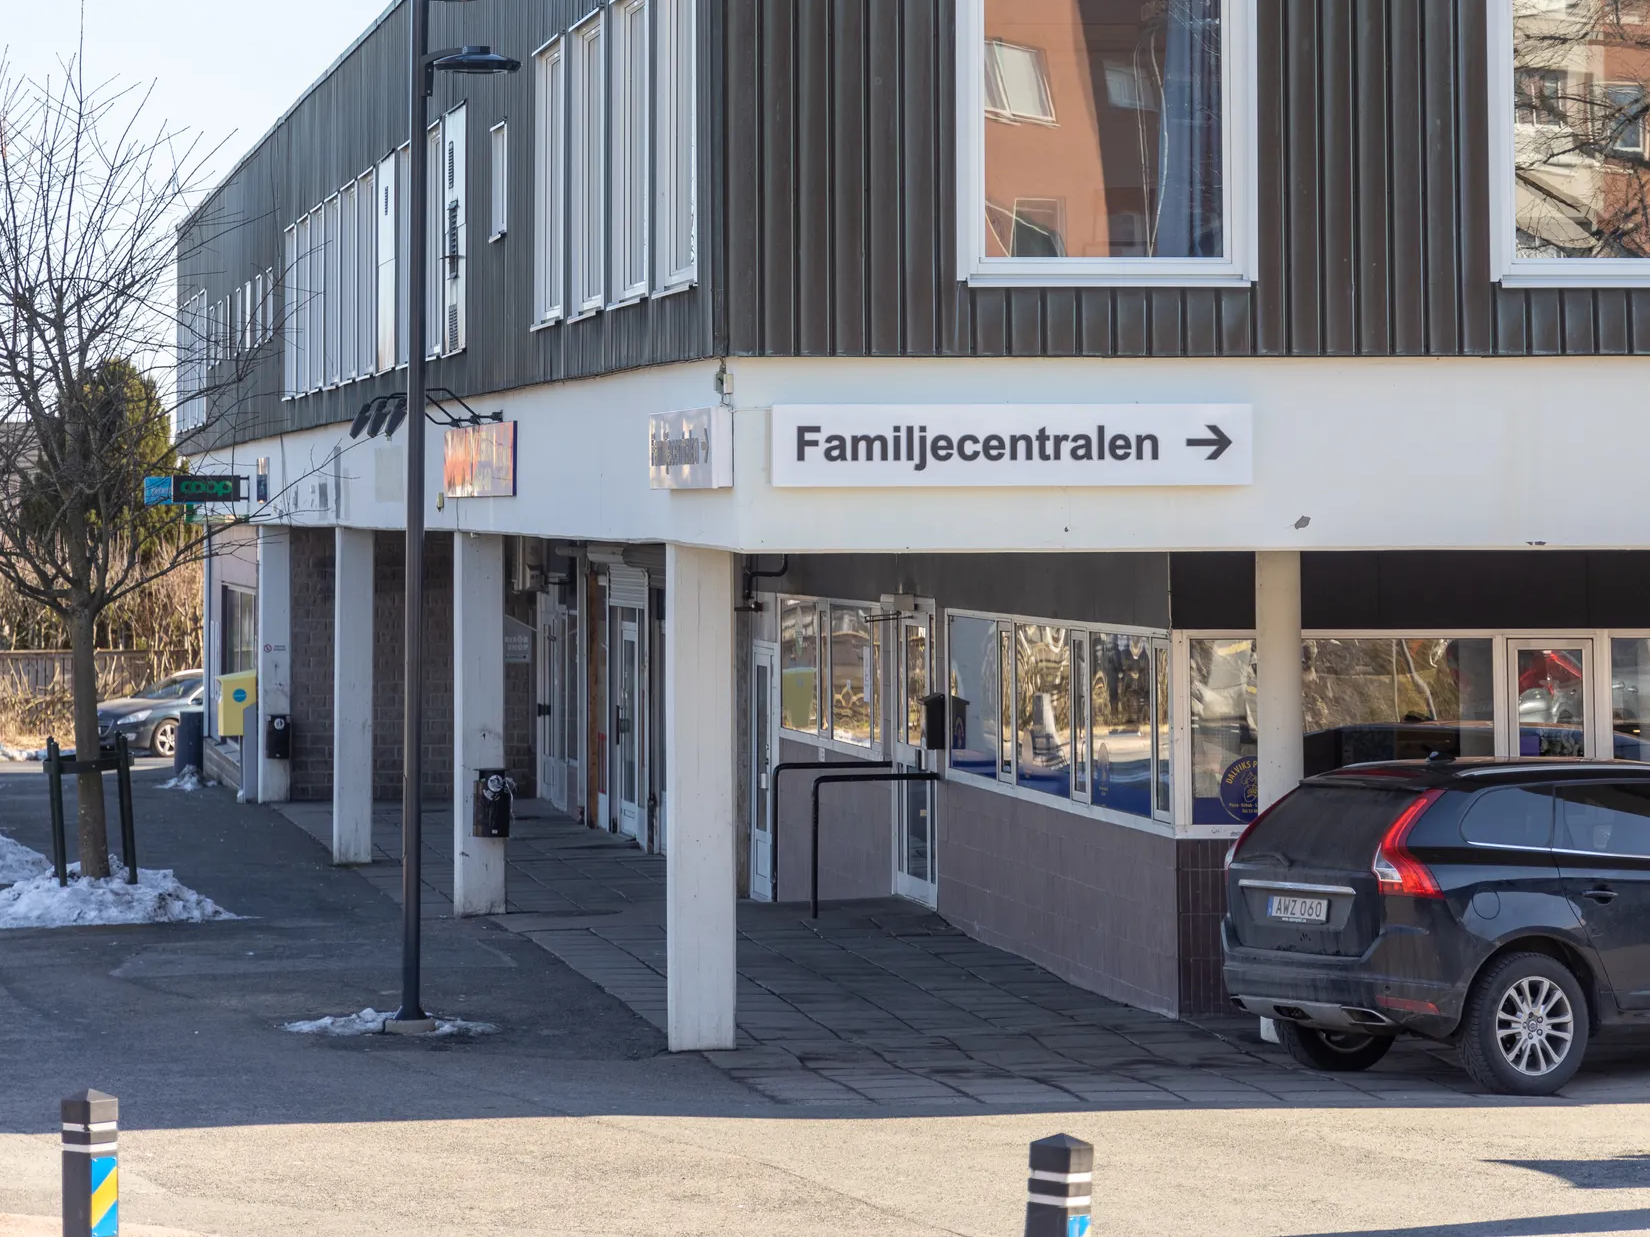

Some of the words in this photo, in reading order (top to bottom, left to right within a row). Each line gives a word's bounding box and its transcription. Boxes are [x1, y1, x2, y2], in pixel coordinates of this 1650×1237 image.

[795, 424, 1160, 472] Familjecentralen
[180, 480, 233, 497] coop
[1225, 760, 1251, 785] DALVIKS
[1275, 897, 1298, 917] AWZ
[1299, 900, 1323, 918] 060
